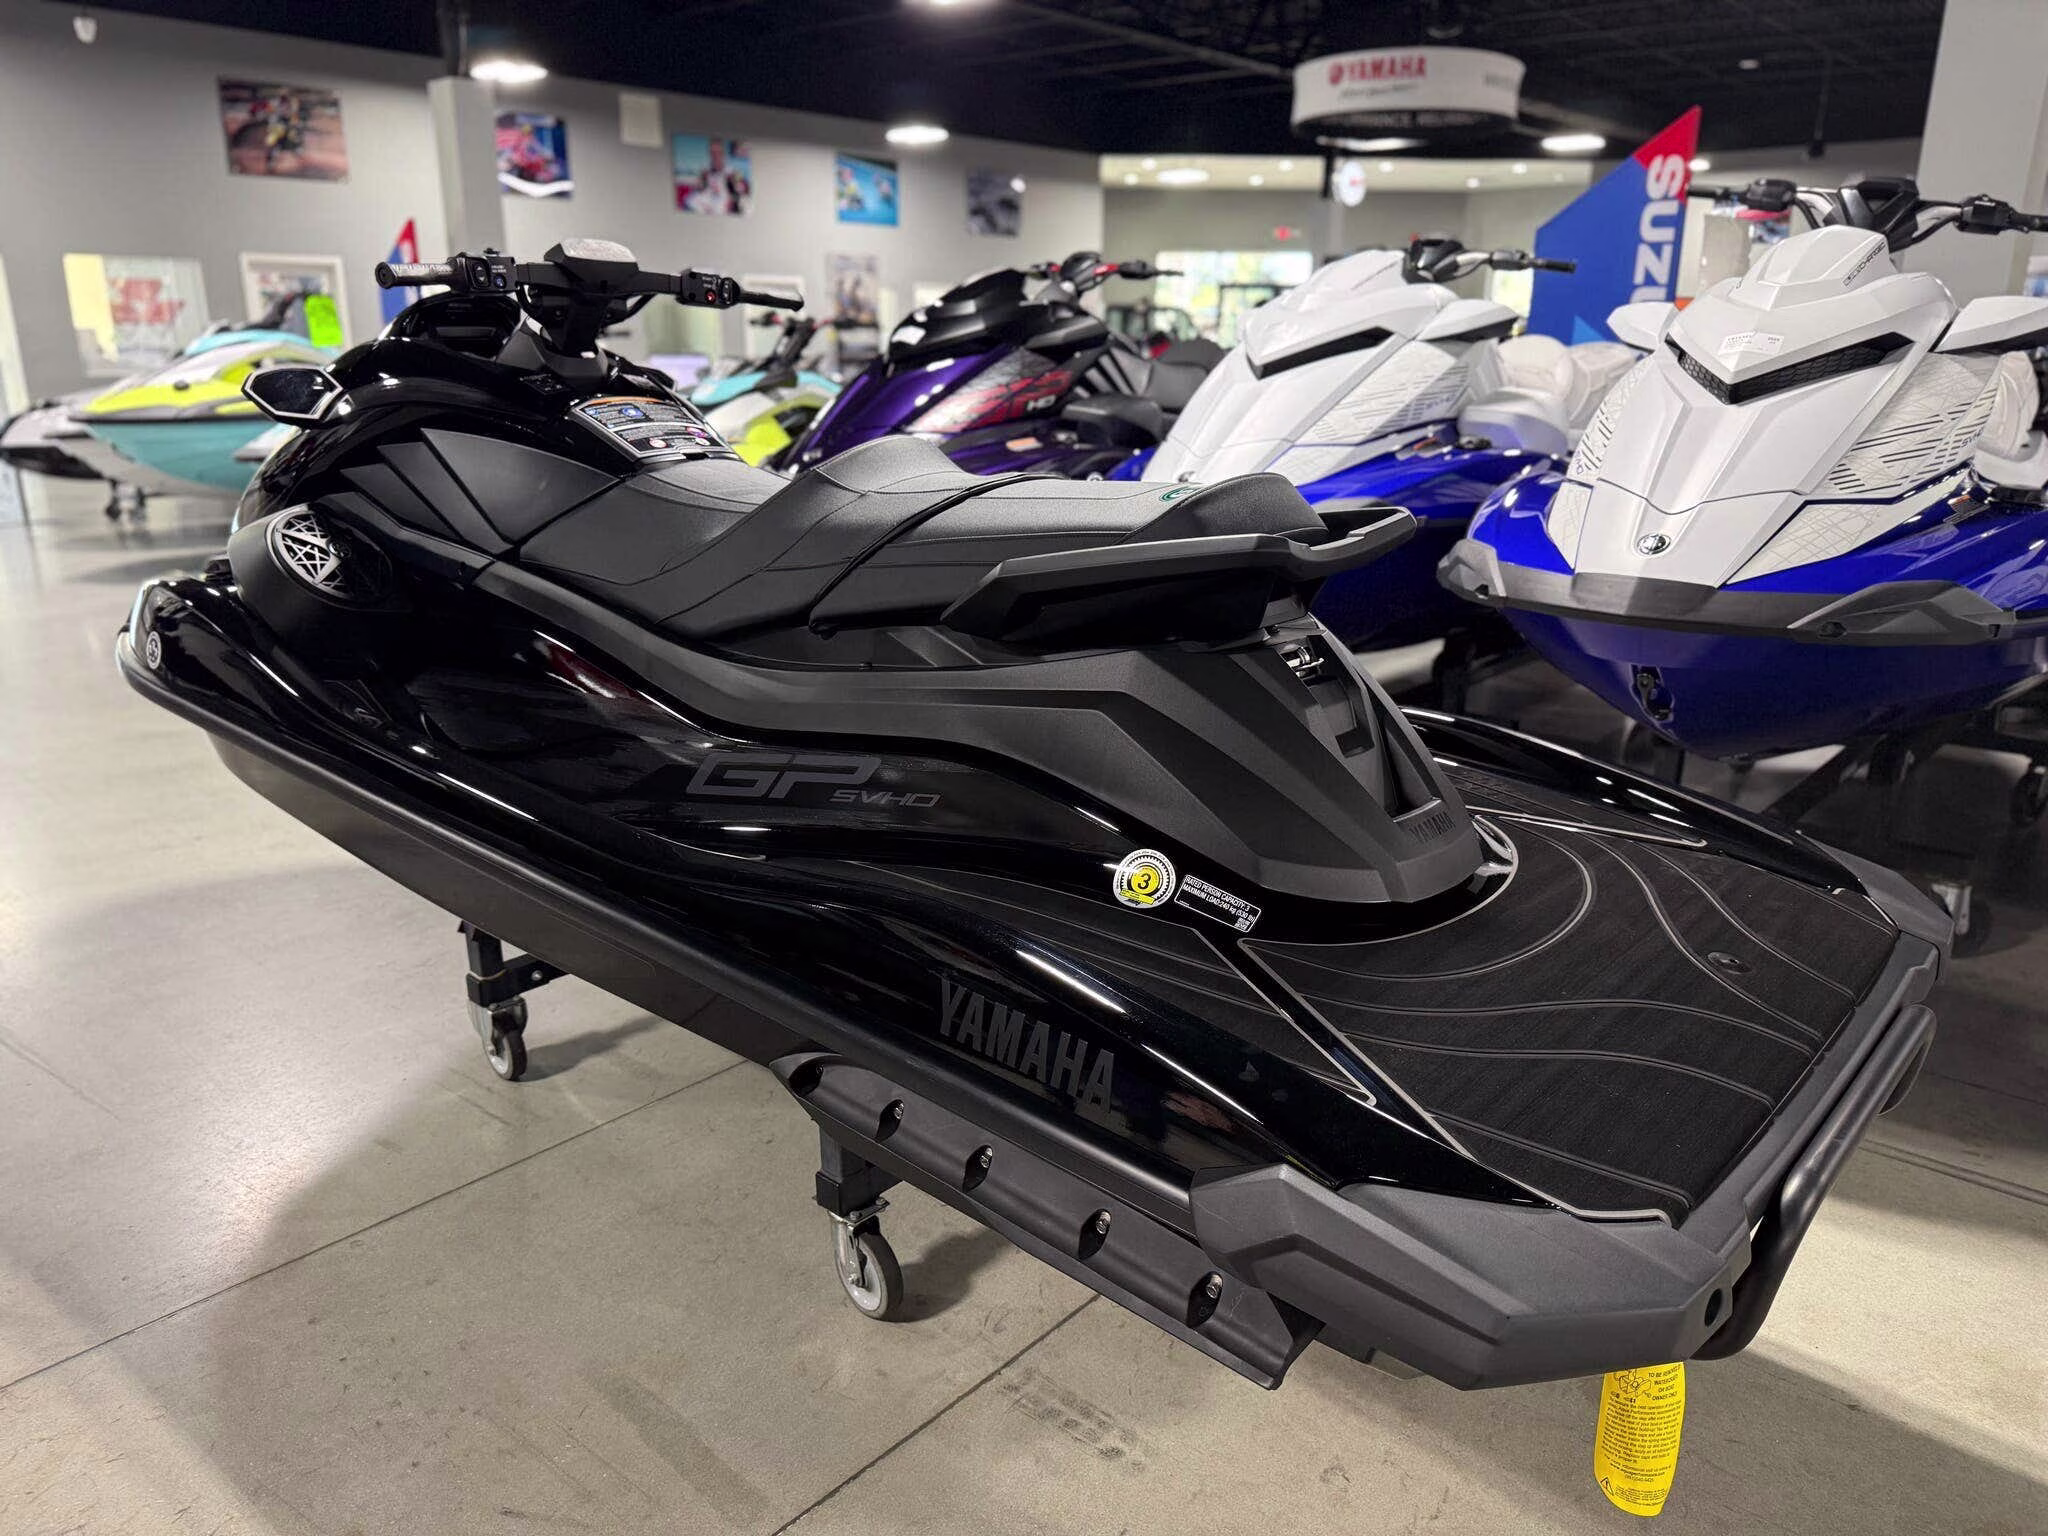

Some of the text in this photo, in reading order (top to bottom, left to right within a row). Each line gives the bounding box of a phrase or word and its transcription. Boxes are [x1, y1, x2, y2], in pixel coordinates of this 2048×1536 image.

[686, 752, 881, 799] GP
[829, 789, 944, 808] SVHO
[1409, 811, 1456, 842] YAMAHA
[1137, 872, 1152, 890] 3
[1183, 884, 1207, 899] MAXIMUM
[1186, 876, 1202, 888] RATED
[1201, 884, 1222, 898] PERSON
[940, 977, 1115, 1116] YAMAHA
